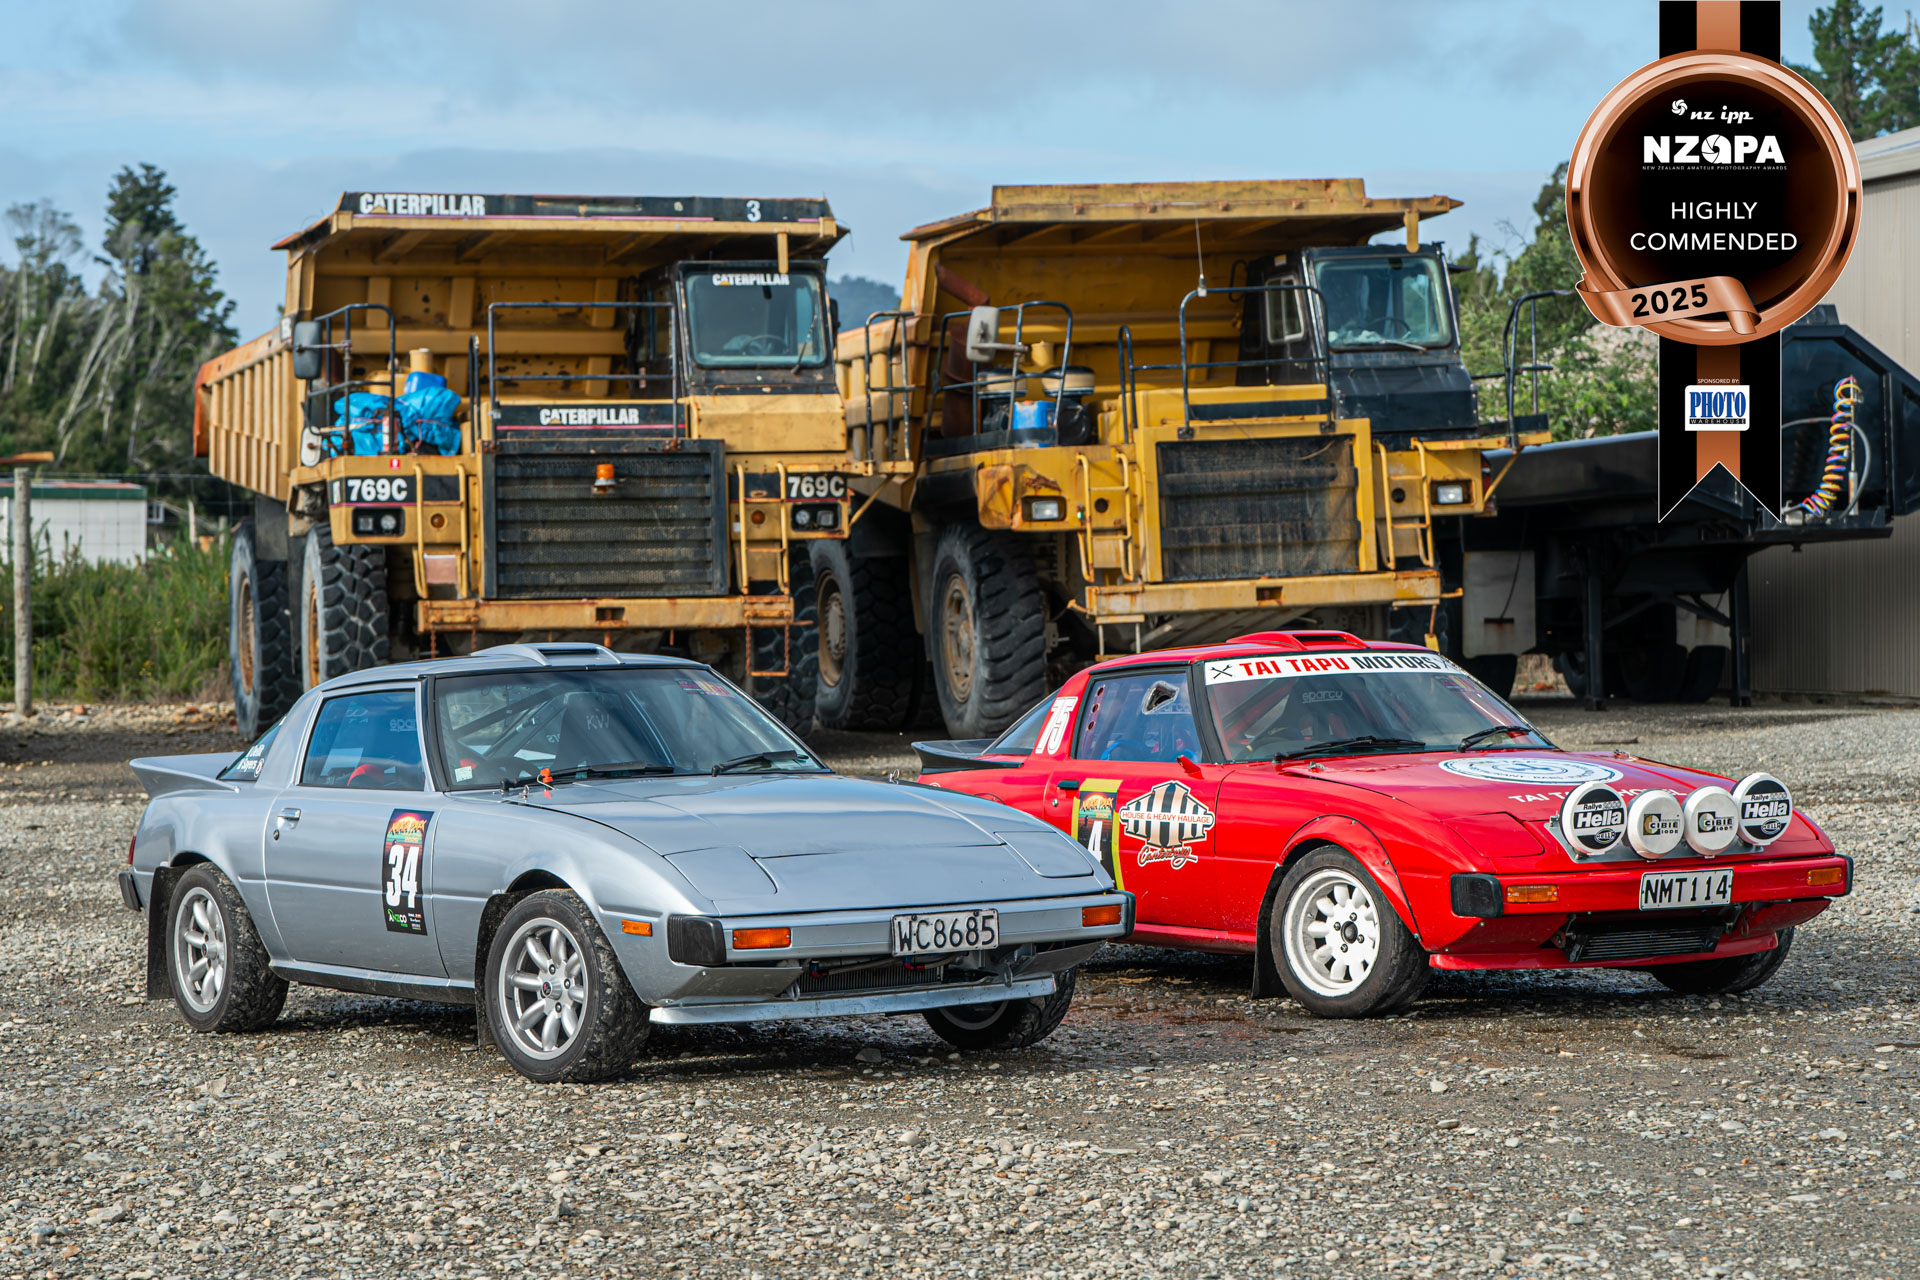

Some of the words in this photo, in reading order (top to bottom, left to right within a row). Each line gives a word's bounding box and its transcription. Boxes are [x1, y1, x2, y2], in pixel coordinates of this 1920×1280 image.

[359, 192, 486, 216] CATERPILLAR
[746, 200, 762, 222] 3
[712, 273, 790, 286] CATERPILLAR
[539, 408, 640, 425] CATERPILLAR
[347, 478, 408, 501] 769C
[787, 475, 845, 498] 769C
[1239, 658, 1282, 676] TAI
[1286, 657, 1350, 672] TAPU
[1351, 656, 1439, 670] MOTORS
[1035, 696, 1078, 755] 75
[1508, 793, 1550, 803] TAI
[1583, 802, 1602, 811] Rallye
[1751, 794, 1769, 802] Rallye
[1122, 811, 1145, 820] HOUSE
[1153, 813, 1177, 821] HEAVY
[1177, 814, 1211, 824] HAULAGE
[1576, 810, 1622, 828] Hella
[1745, 801, 1788, 818] Hella
[1087, 820, 1103, 861] 4
[386, 844, 420, 909] 34
[1644, 874, 1729, 904] NMT114
[897, 914, 995, 952] WC8685
